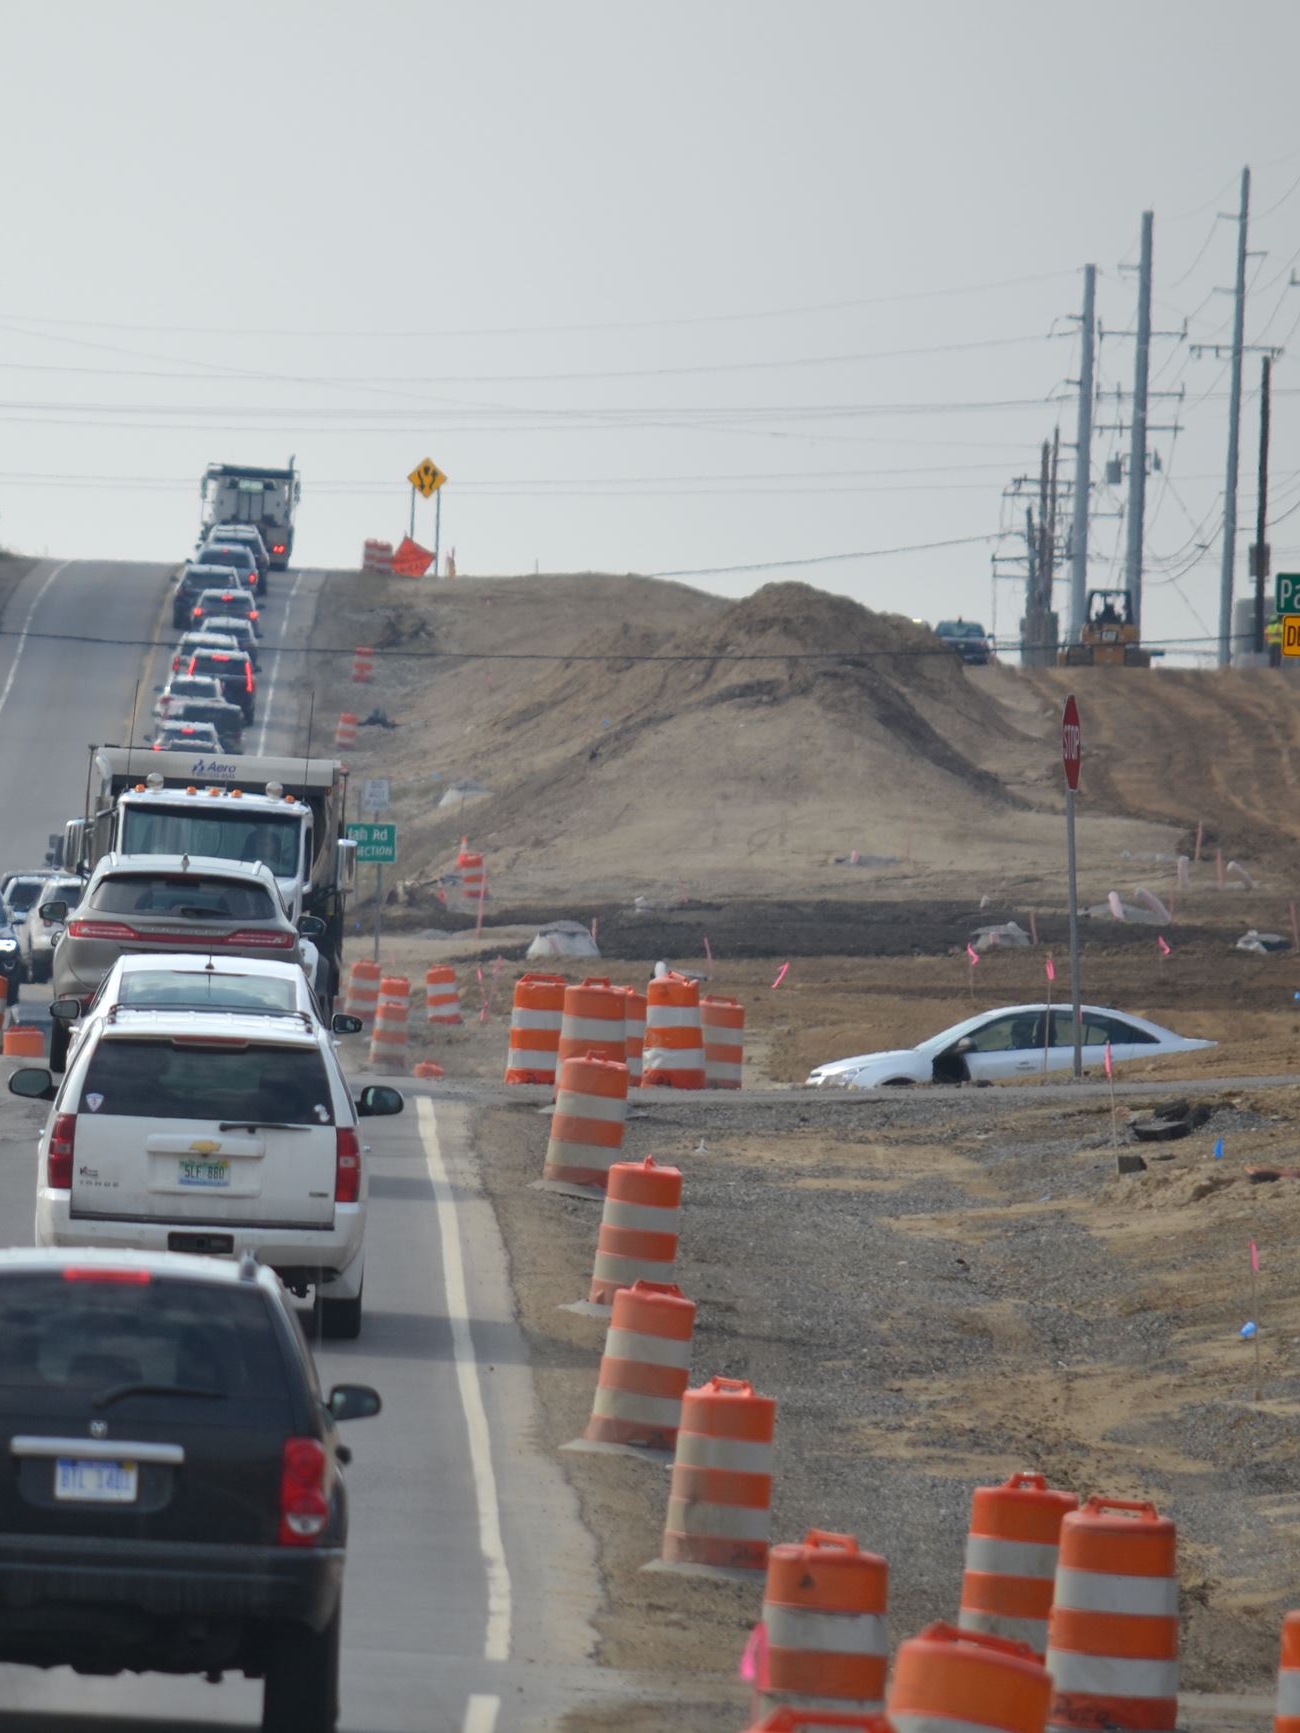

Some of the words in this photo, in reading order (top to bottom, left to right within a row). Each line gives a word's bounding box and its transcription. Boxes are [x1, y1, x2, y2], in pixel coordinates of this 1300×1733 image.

[1064, 724, 1080, 760] STOP
[207, 761, 237, 773] Aero
[373, 828, 388, 841] Rd
